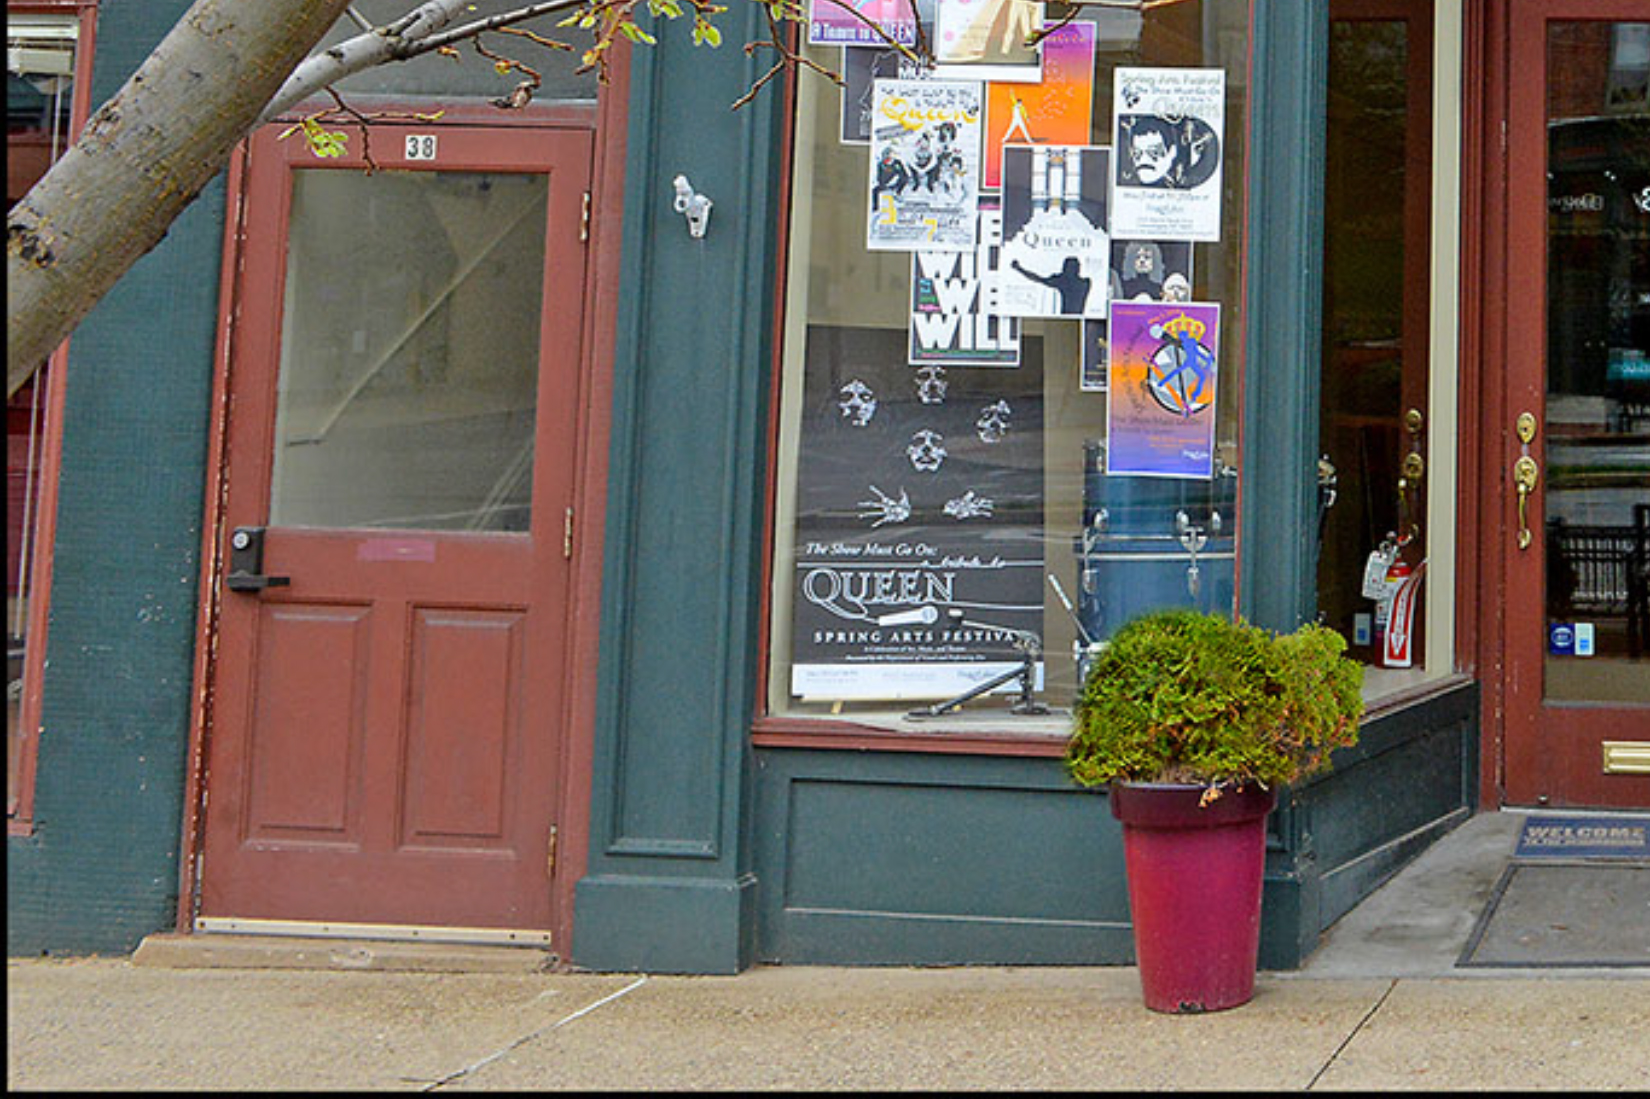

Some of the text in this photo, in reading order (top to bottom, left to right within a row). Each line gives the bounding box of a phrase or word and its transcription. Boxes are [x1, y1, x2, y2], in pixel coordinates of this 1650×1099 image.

[408, 137, 433, 157] 38
[1024, 232, 1092, 248] Queen
[913, 313, 1019, 350] WILL
[806, 542, 827, 555] The
[831, 543, 861, 556] Show
[863, 543, 893, 556] Must
[896, 543, 913, 556] Go
[803, 567, 956, 620] QUEEN
[814, 630, 1015, 643] SPRING ARTS FESTIVA
[1528, 826, 1645, 838] WELCOME
